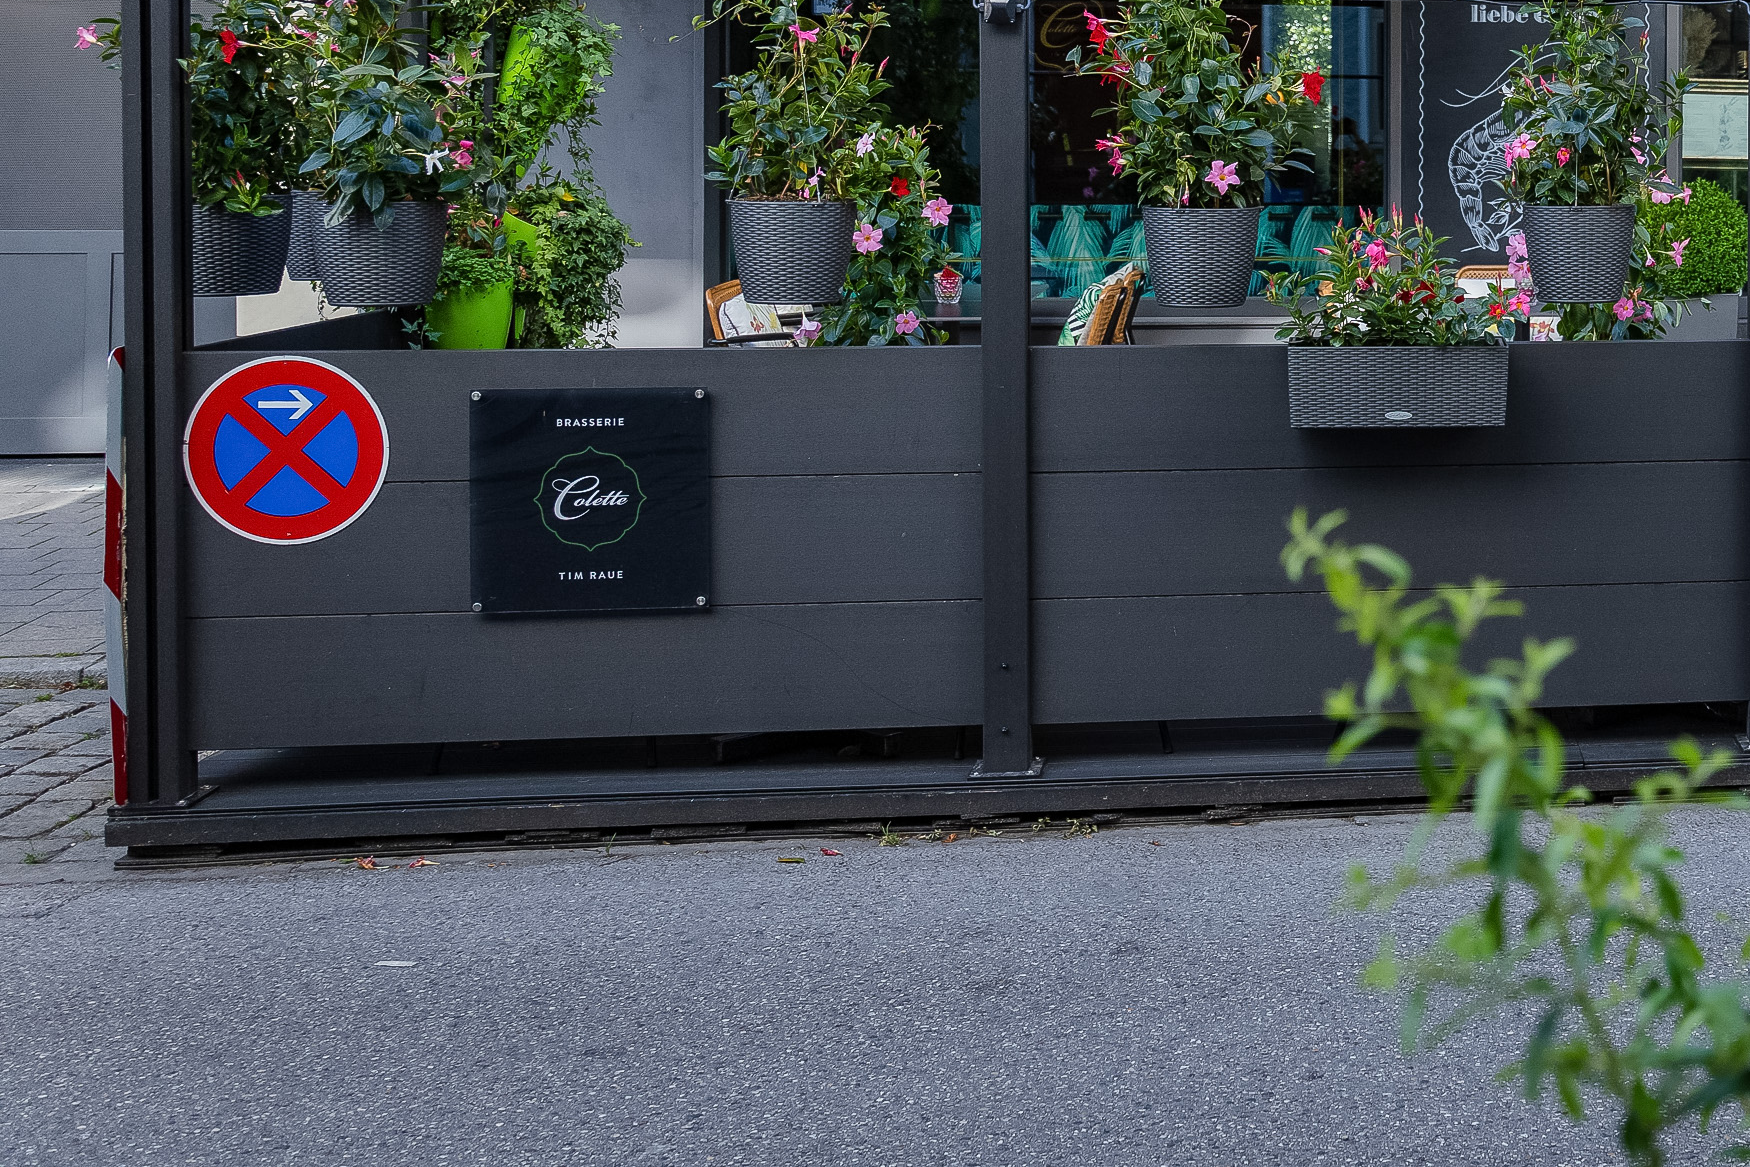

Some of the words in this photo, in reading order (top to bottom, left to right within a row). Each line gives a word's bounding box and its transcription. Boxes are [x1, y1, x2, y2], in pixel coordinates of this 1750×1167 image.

[1470, 4, 1529, 23] liebe
[556, 417, 625, 428] BRASSERIE
[551, 475, 630, 521] Colette
[558, 571, 584, 581] TIM
[589, 570, 624, 580] RAUE
